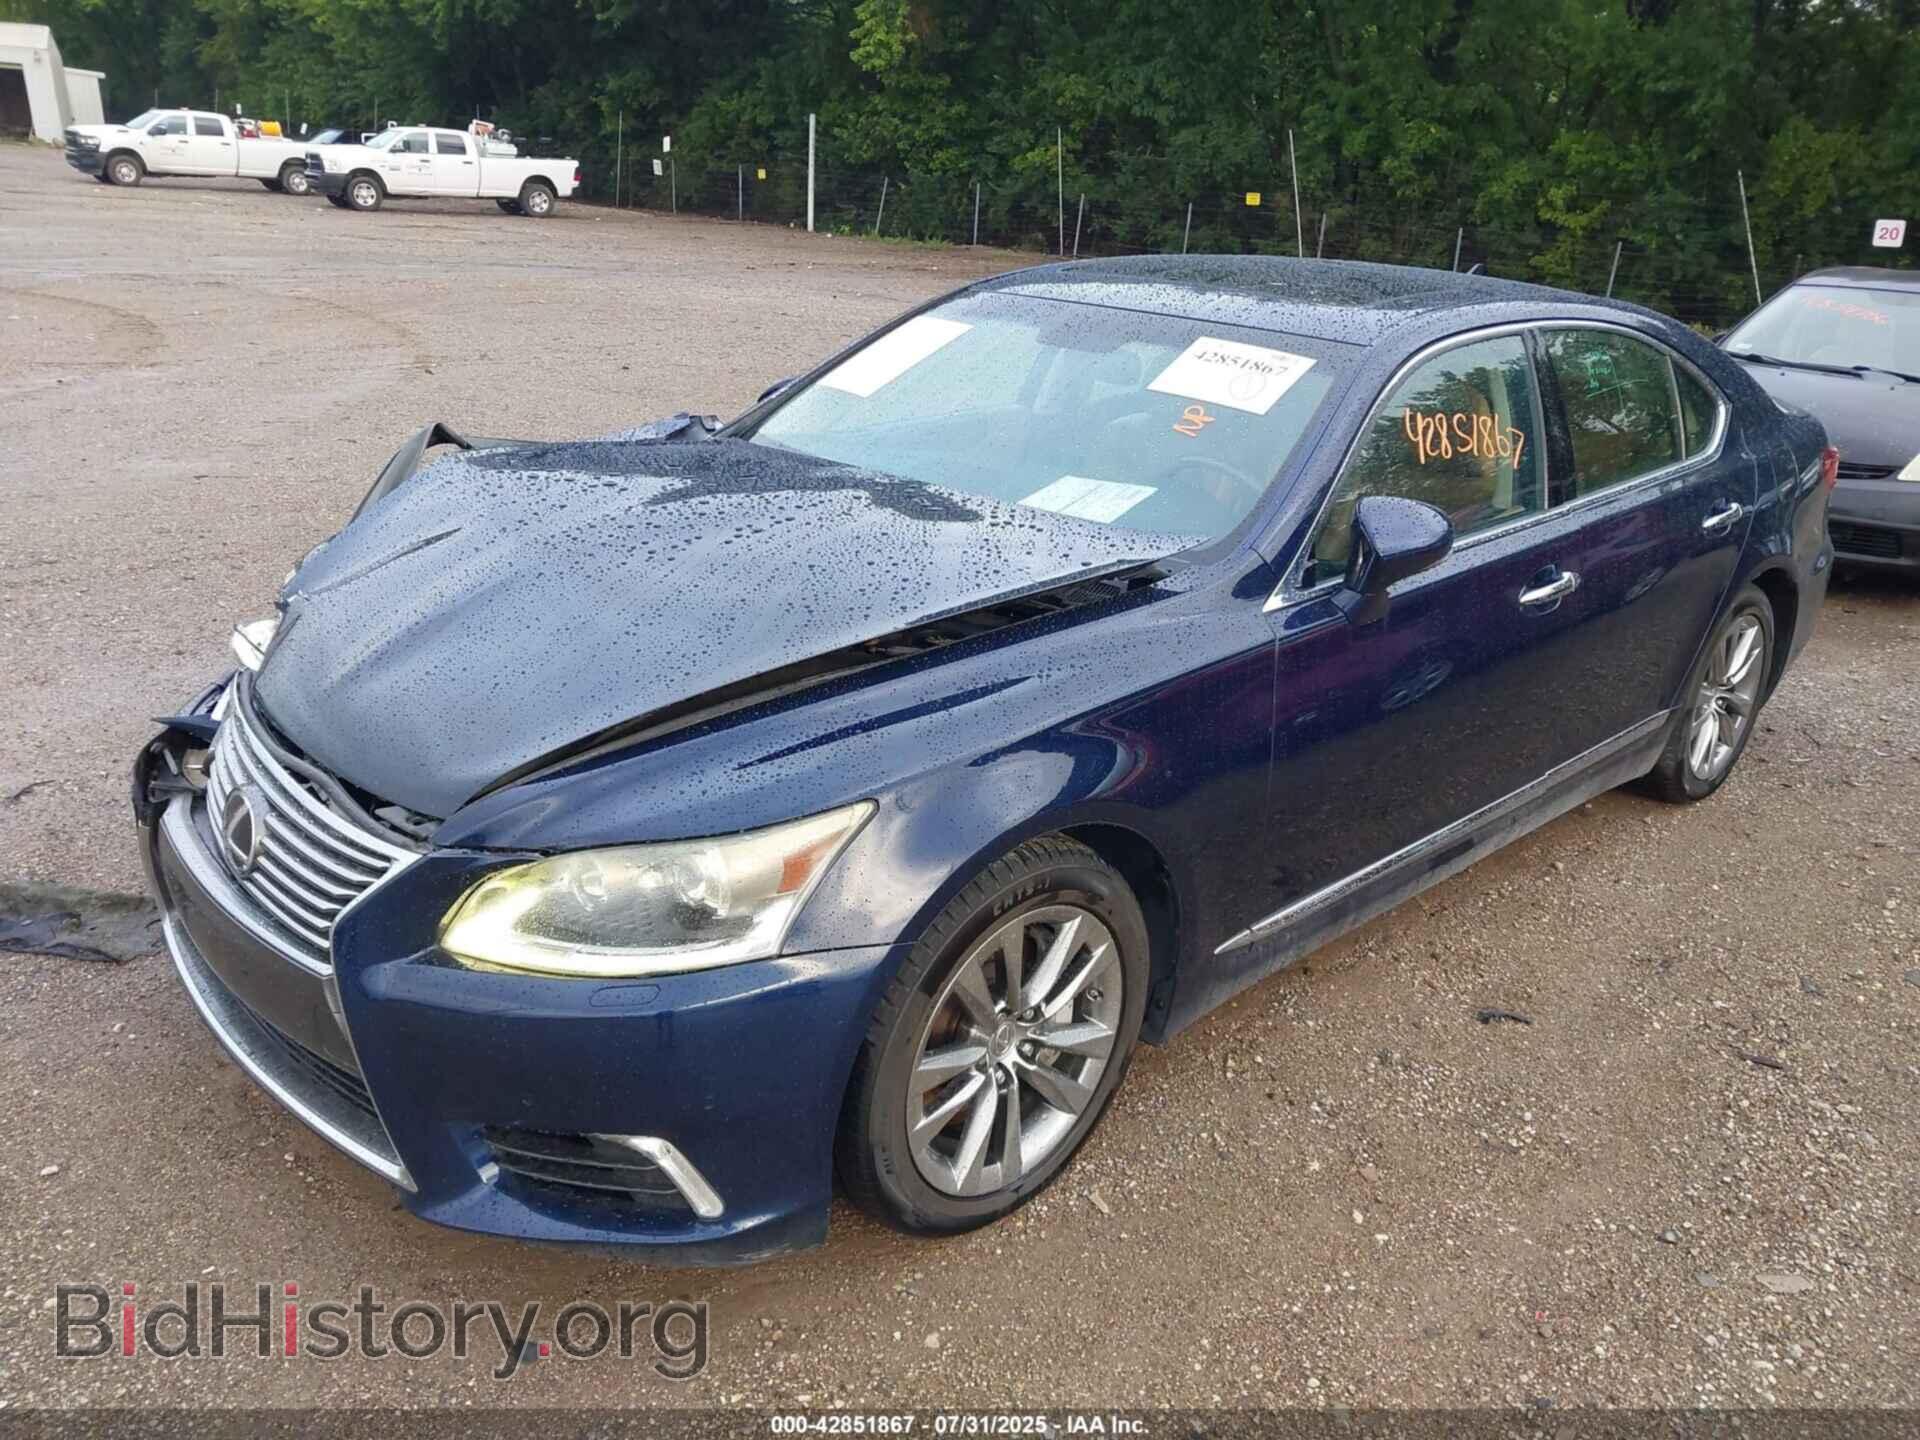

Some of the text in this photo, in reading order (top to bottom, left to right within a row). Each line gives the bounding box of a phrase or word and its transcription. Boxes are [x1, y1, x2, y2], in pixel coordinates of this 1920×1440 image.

[1878, 226, 1901, 241] 20
[1193, 350, 1289, 377] 42851867
[1405, 407, 1525, 470] 42851867
